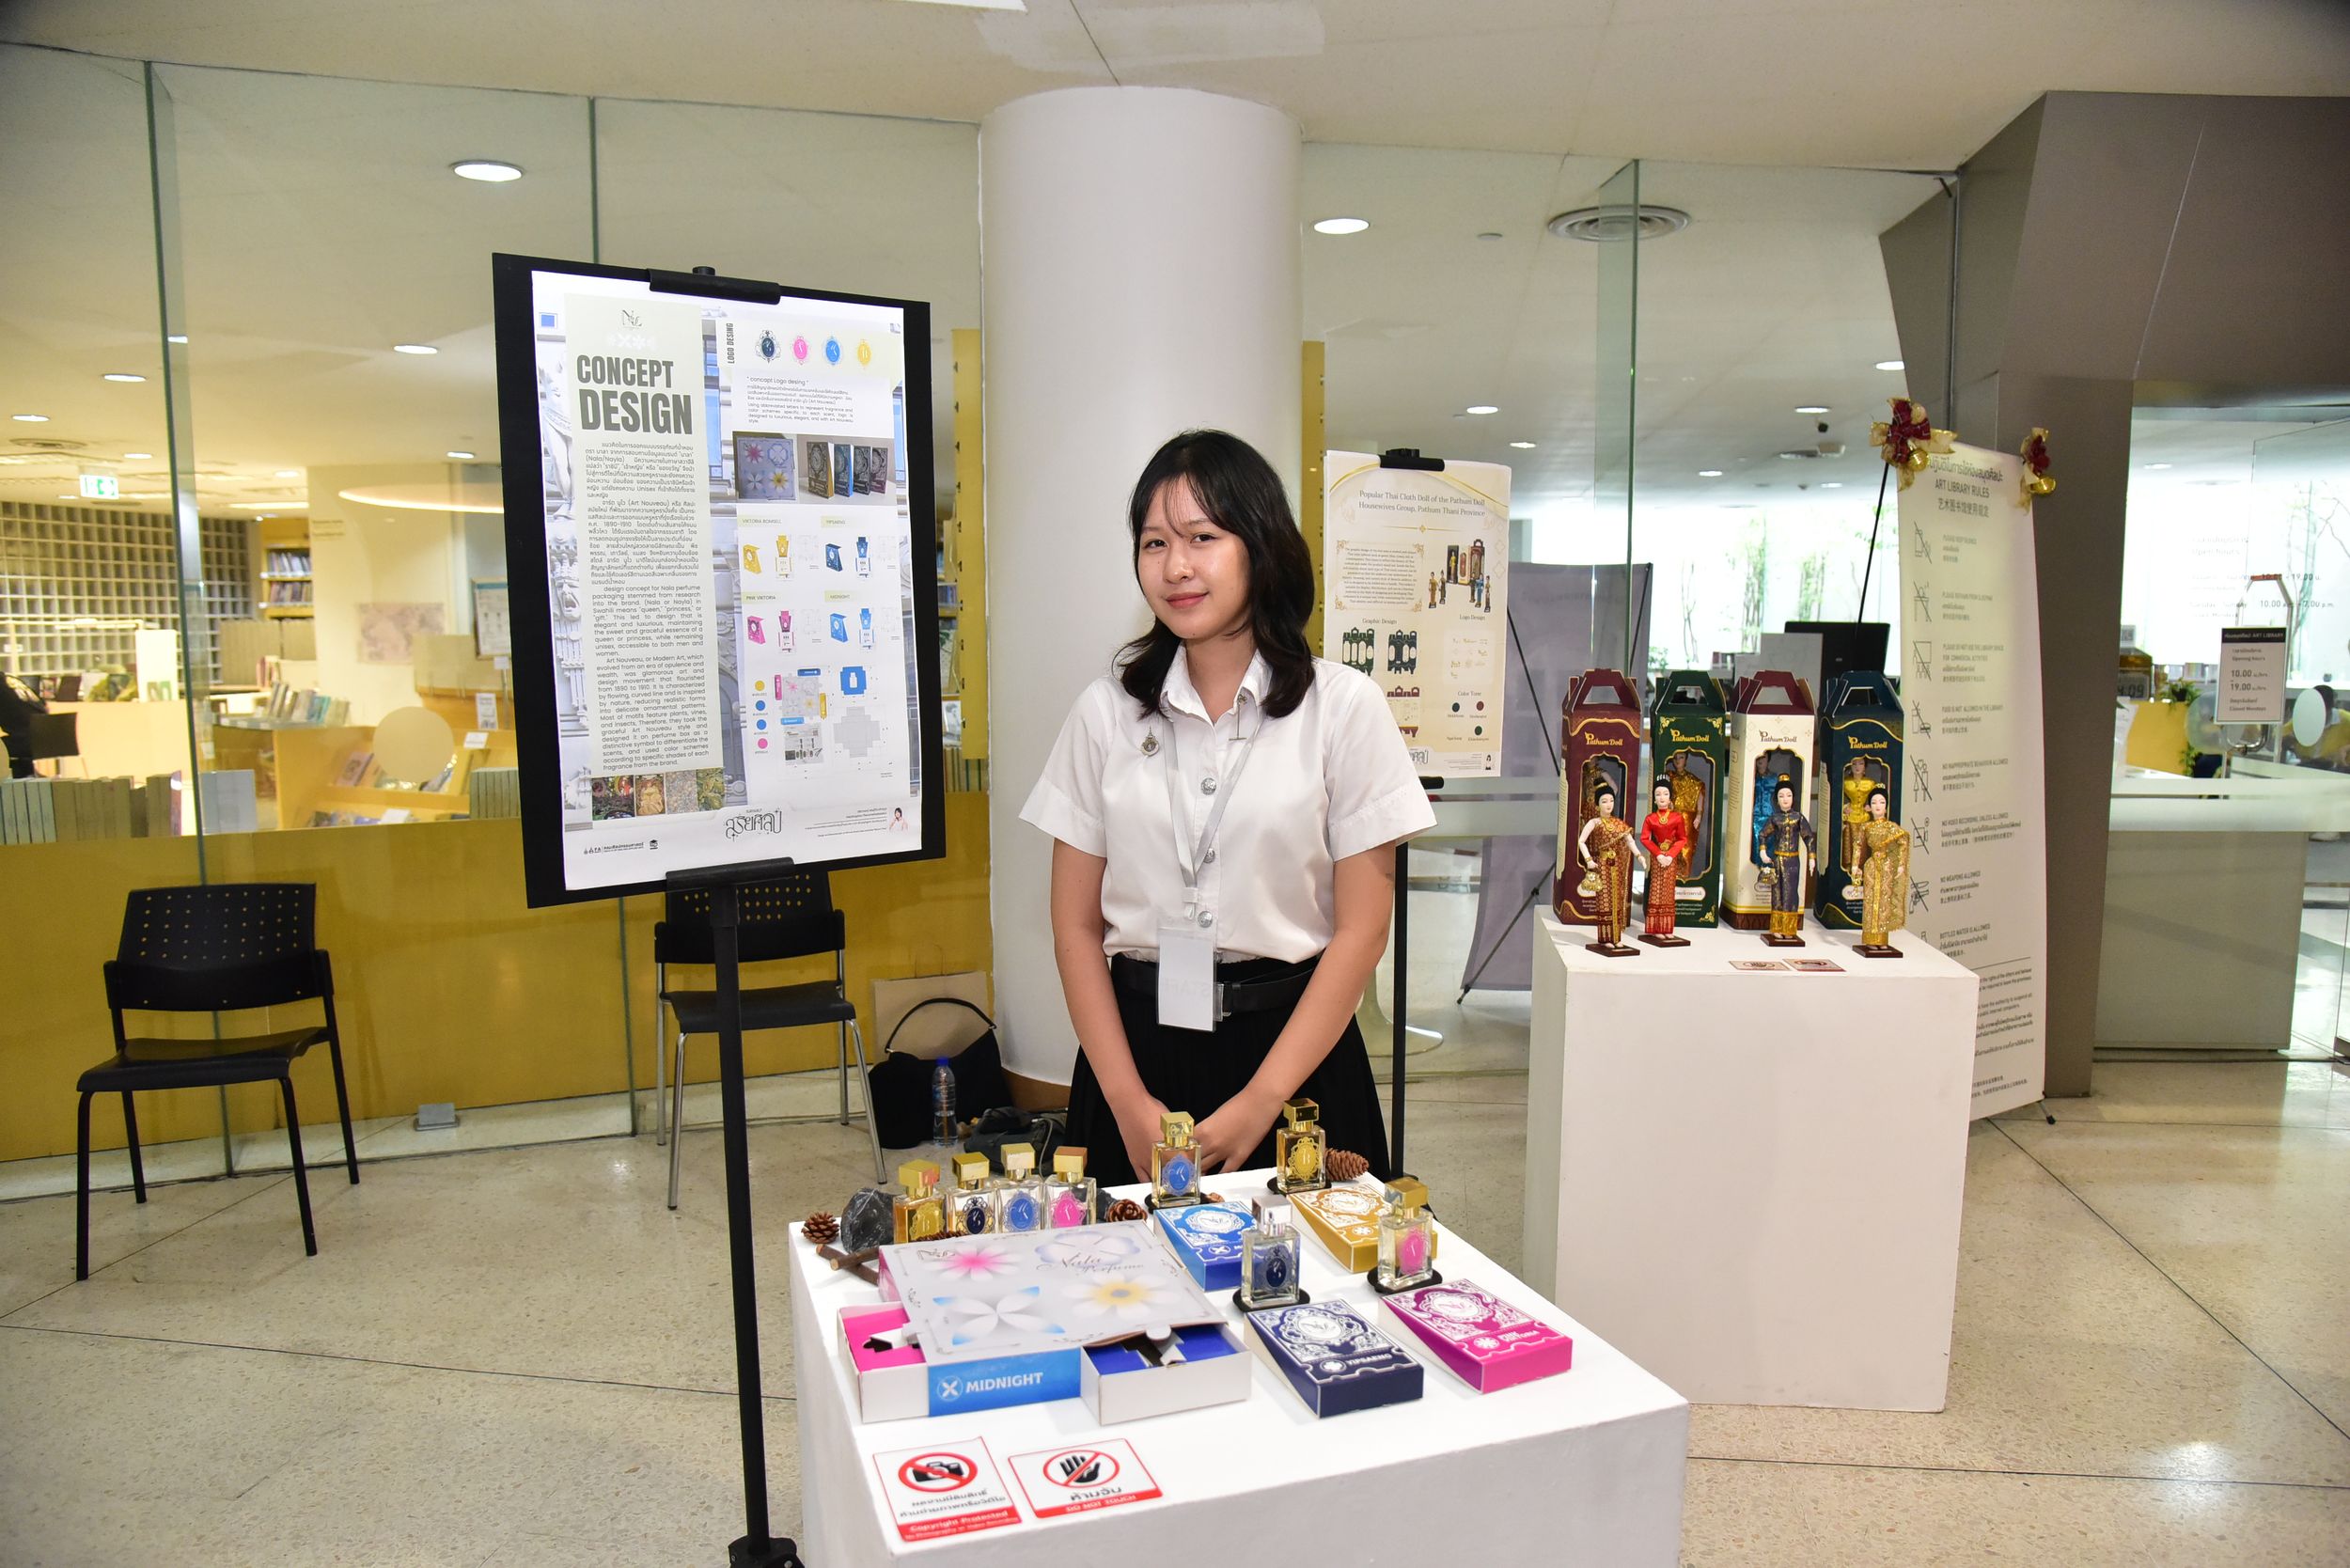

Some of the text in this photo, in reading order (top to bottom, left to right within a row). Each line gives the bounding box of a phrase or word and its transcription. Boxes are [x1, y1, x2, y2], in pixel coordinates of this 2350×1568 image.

[727, 348, 735, 364] LOGO
[576, 354, 674, 388] CONCEPT
[578, 388, 693, 435] DESIGN
[1935, 478, 1990, 498] ART LIBRARY RULES
[1359, 490, 1383, 499] Popular
[1399, 493, 1416, 501] Cloth
[1449, 497, 1472, 505] Pathum
[1359, 502, 1395, 511] Housewives
[1418, 505, 1441, 514] Pathum
[1460, 508, 1486, 516] Province
[676, 584, 701, 593] perfume
[592, 593, 625, 601] packaging
[594, 621, 618, 629] elegant
[668, 619, 703, 627] maintaining
[656, 613, 677, 621] design
[639, 627, 665, 635] graceful
[1584, 731, 1609, 745] Pathum
[1670, 729, 1696, 742] Pathum
[1758, 729, 1783, 742] Pathum
[1848, 735, 1873, 749] Pathum
[603, 755, 634, 765] according
[642, 753, 665, 762] specific
[603, 762, 633, 772] fragrance
[964, 1372, 1043, 1394] MIDNIGHT
[1070, 1487, 1122, 1501] ห้ามจับ
[909, 1510, 1008, 1532] Copyright Protected
